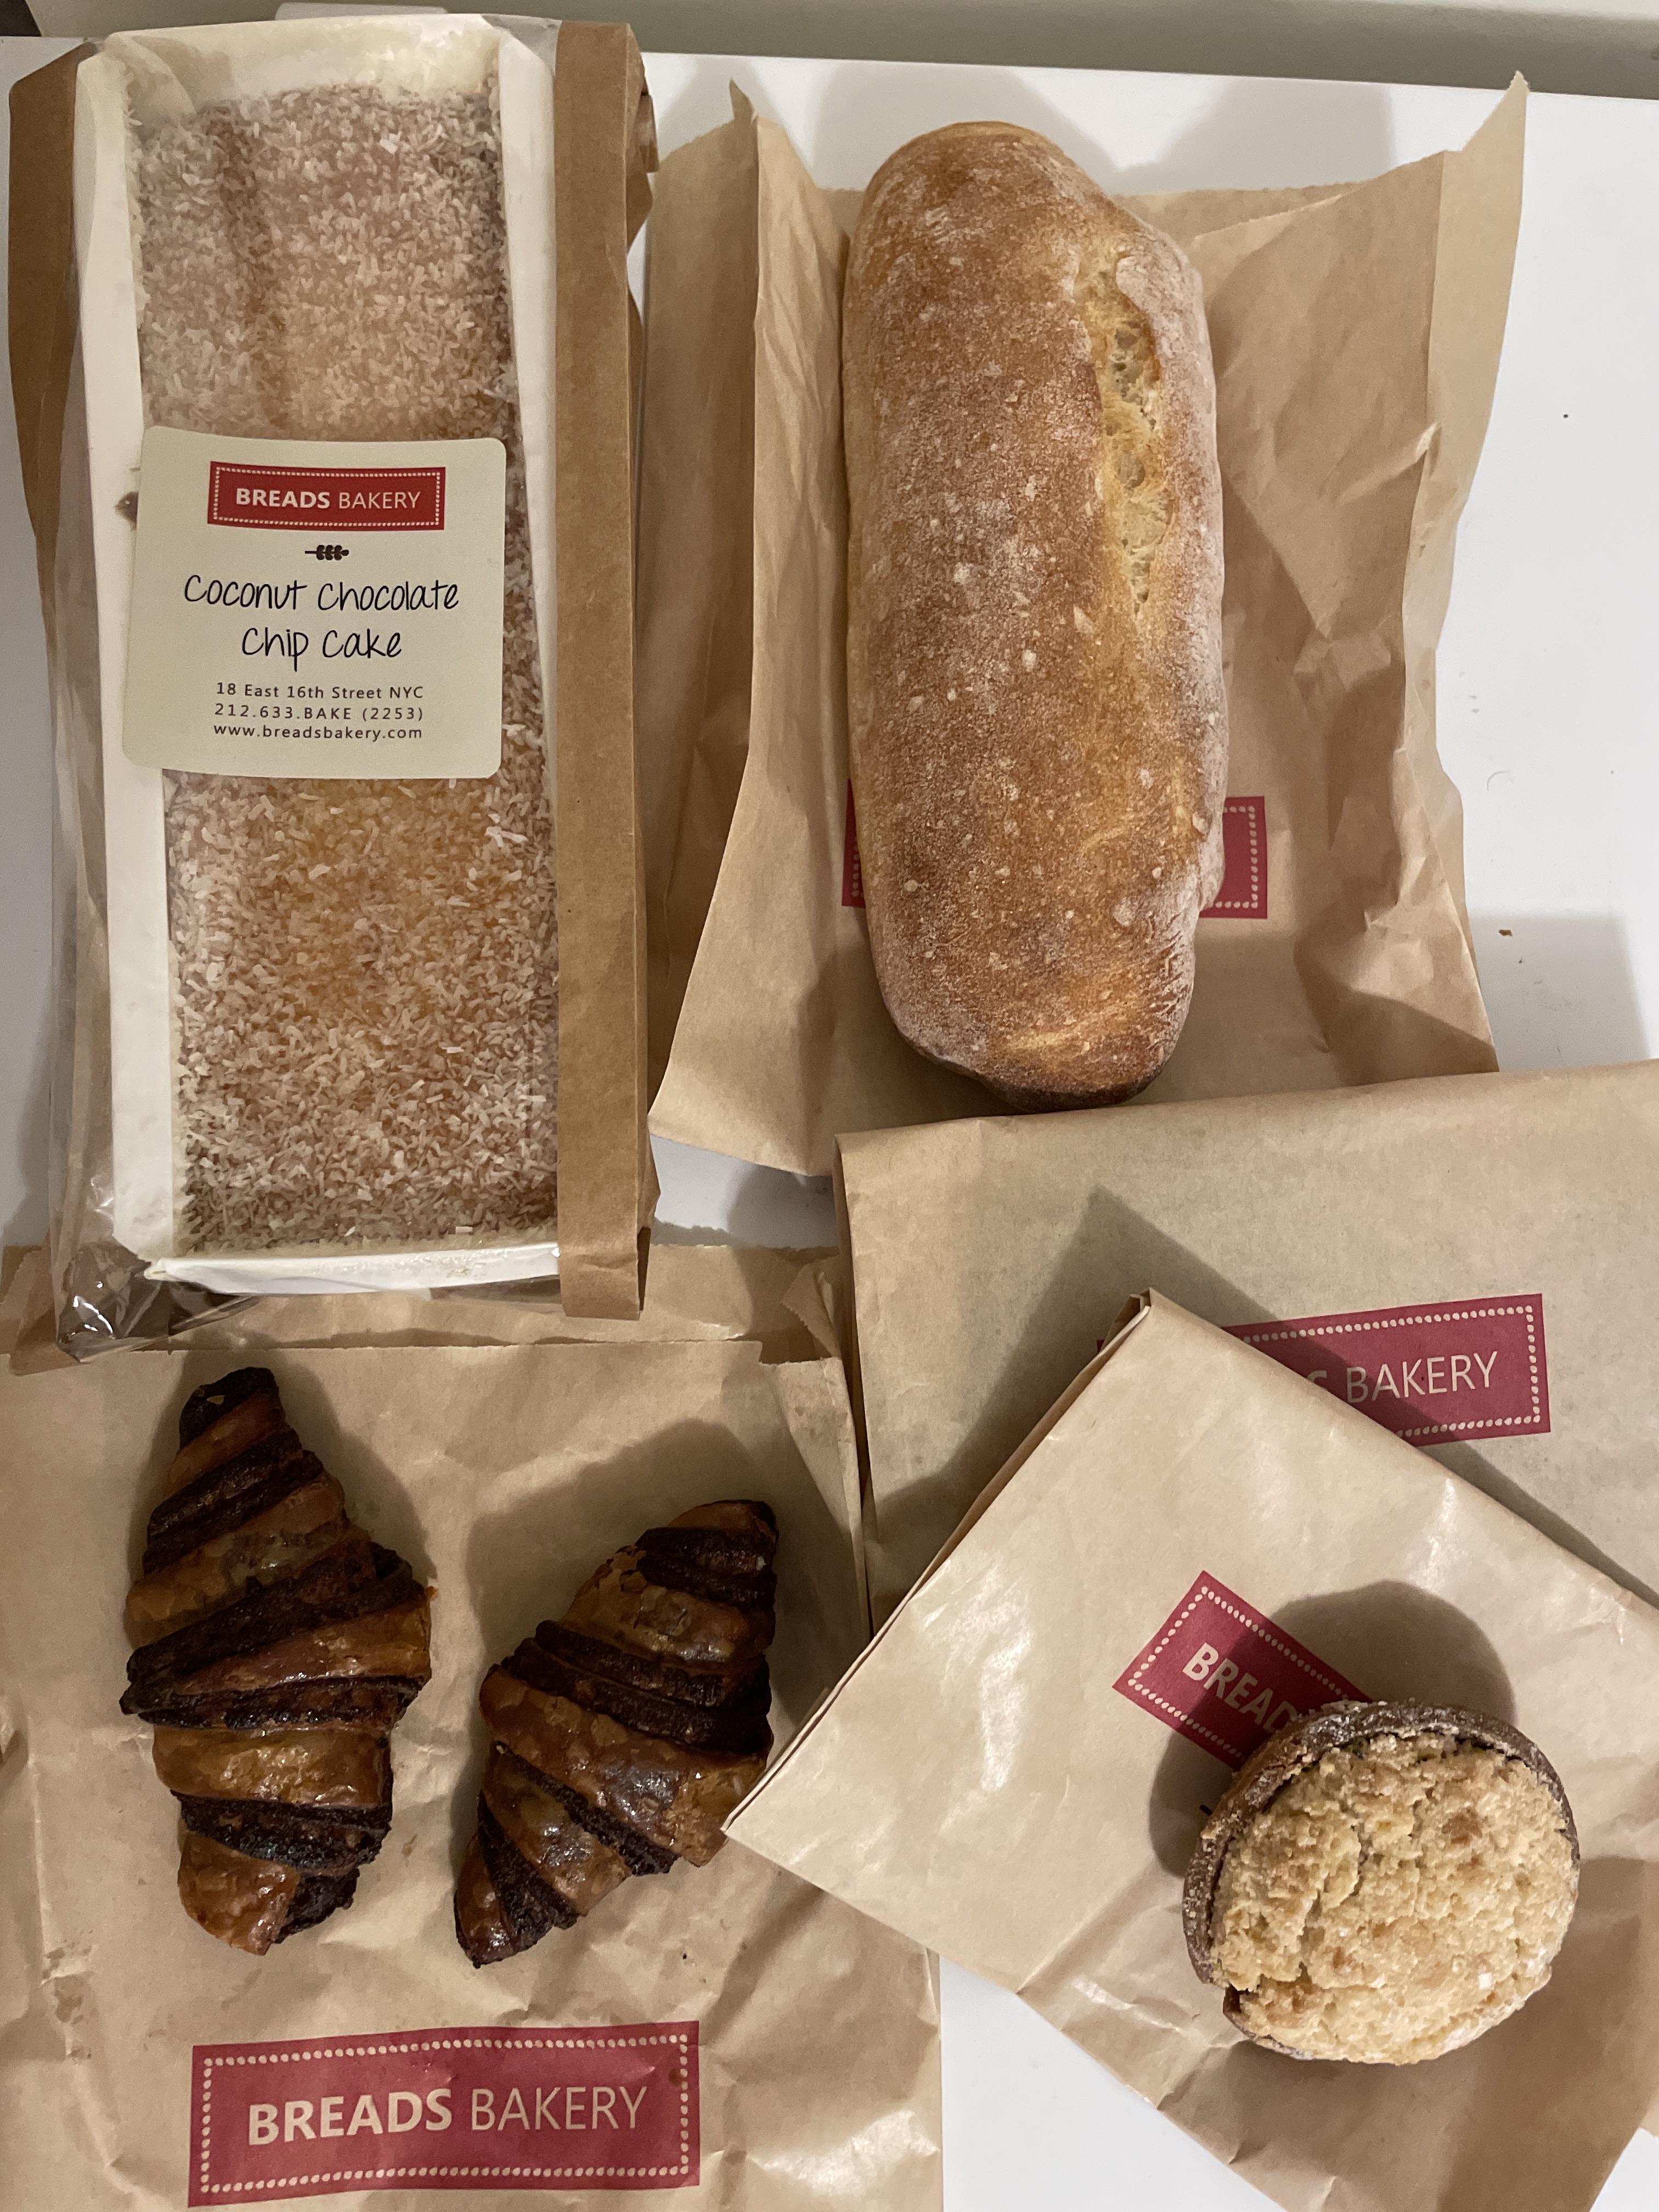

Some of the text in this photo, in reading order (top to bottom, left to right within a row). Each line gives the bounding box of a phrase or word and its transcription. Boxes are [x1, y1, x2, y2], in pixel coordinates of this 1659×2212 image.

[235, 488, 421, 510] BREADS BAKERY
[184, 574, 308, 610] Coconut
[241, 627, 309, 673] Chip
[217, 682, 424, 699] 18 East 16th Street NYC
[214, 703, 423, 722] 212.633.BAKE (2253)
[213, 725, 422, 742] www.breadsbakery.com
[1346, 1351, 1499, 1403] BAKERY
[1182, 1642, 1298, 1733] BREAD
[247, 2085, 648, 2146] BREADS BAKERY
